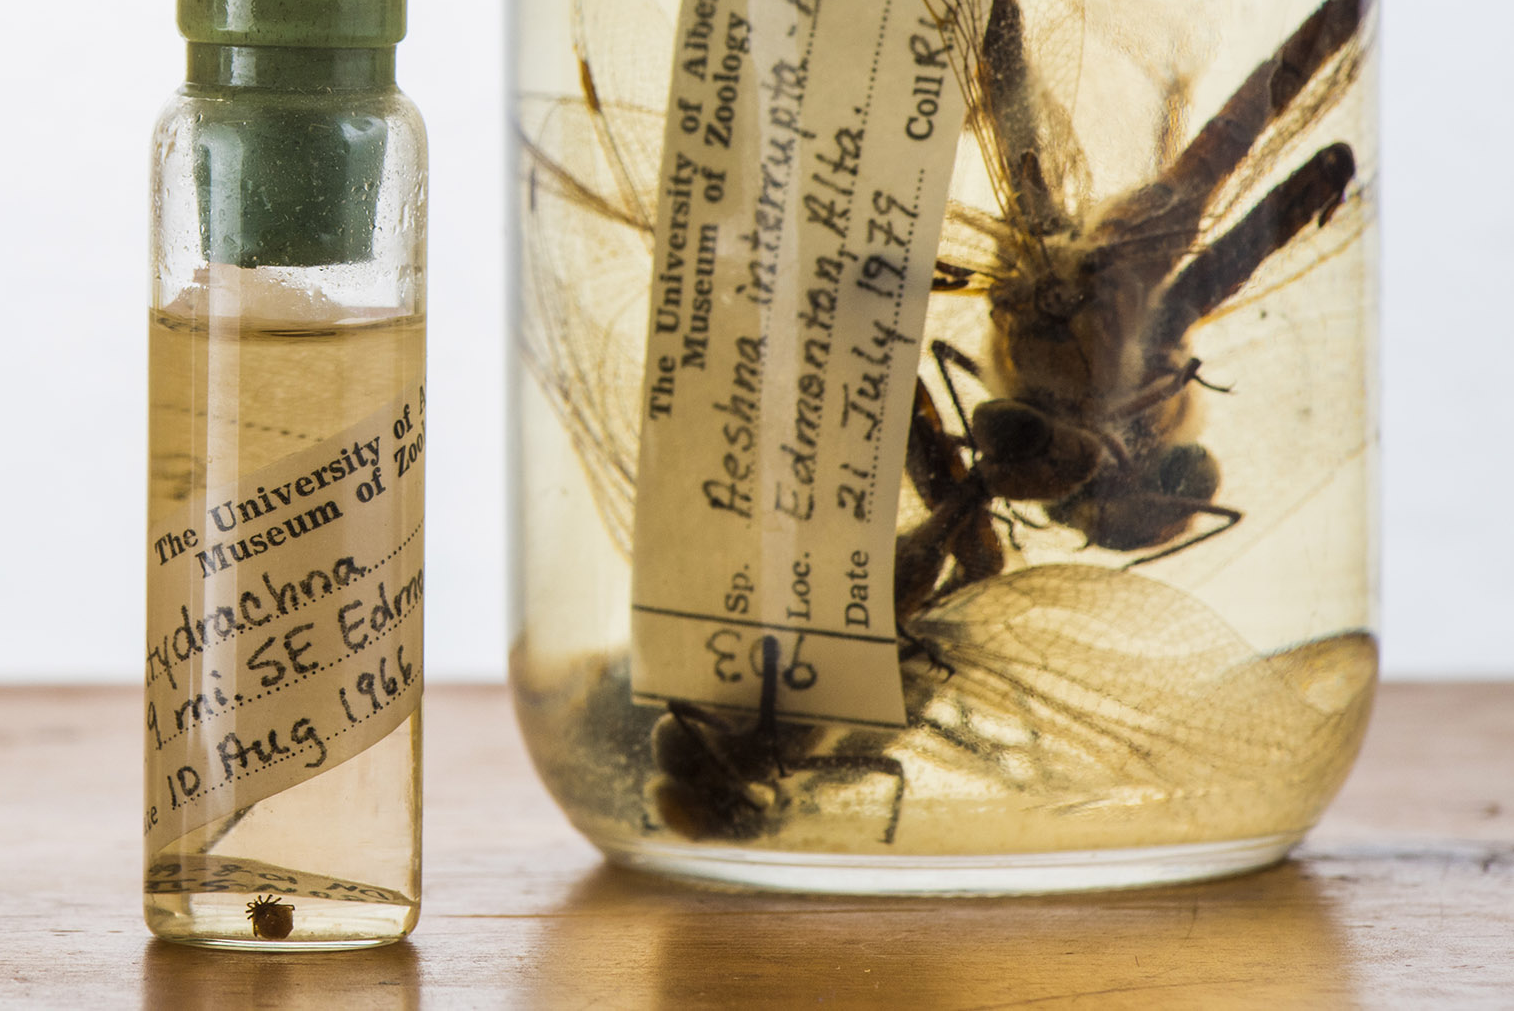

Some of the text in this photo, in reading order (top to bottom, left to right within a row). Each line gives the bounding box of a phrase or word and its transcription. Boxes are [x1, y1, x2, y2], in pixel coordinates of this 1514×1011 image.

[678, 98, 703, 135] of
[906, 75, 944, 141] Coll
[682, 11, 753, 371] Museum of Zoology
[736, 58, 818, 306] interrupta
[654, 151, 700, 335] University
[858, 190, 918, 299] 1979
[649, 355, 676, 421] The
[787, 551, 811, 621] Loc.
[804, 107, 864, 238] Alta.
[841, 321, 916, 443] July
[702, 334, 768, 519] Aeshna
[154, 528, 199, 566] The
[207, 436, 381, 533] University
[394, 403, 413, 440] of
[195, 499, 344, 579] Museum
[355, 467, 387, 503] of
[837, 463, 869, 521] 21
[725, 563, 755, 615] Sp.
[845, 550, 869, 629] Date
[247, 622, 319, 688] SE
[217, 717, 327, 780] Aug
[339, 644, 412, 723] 1966
